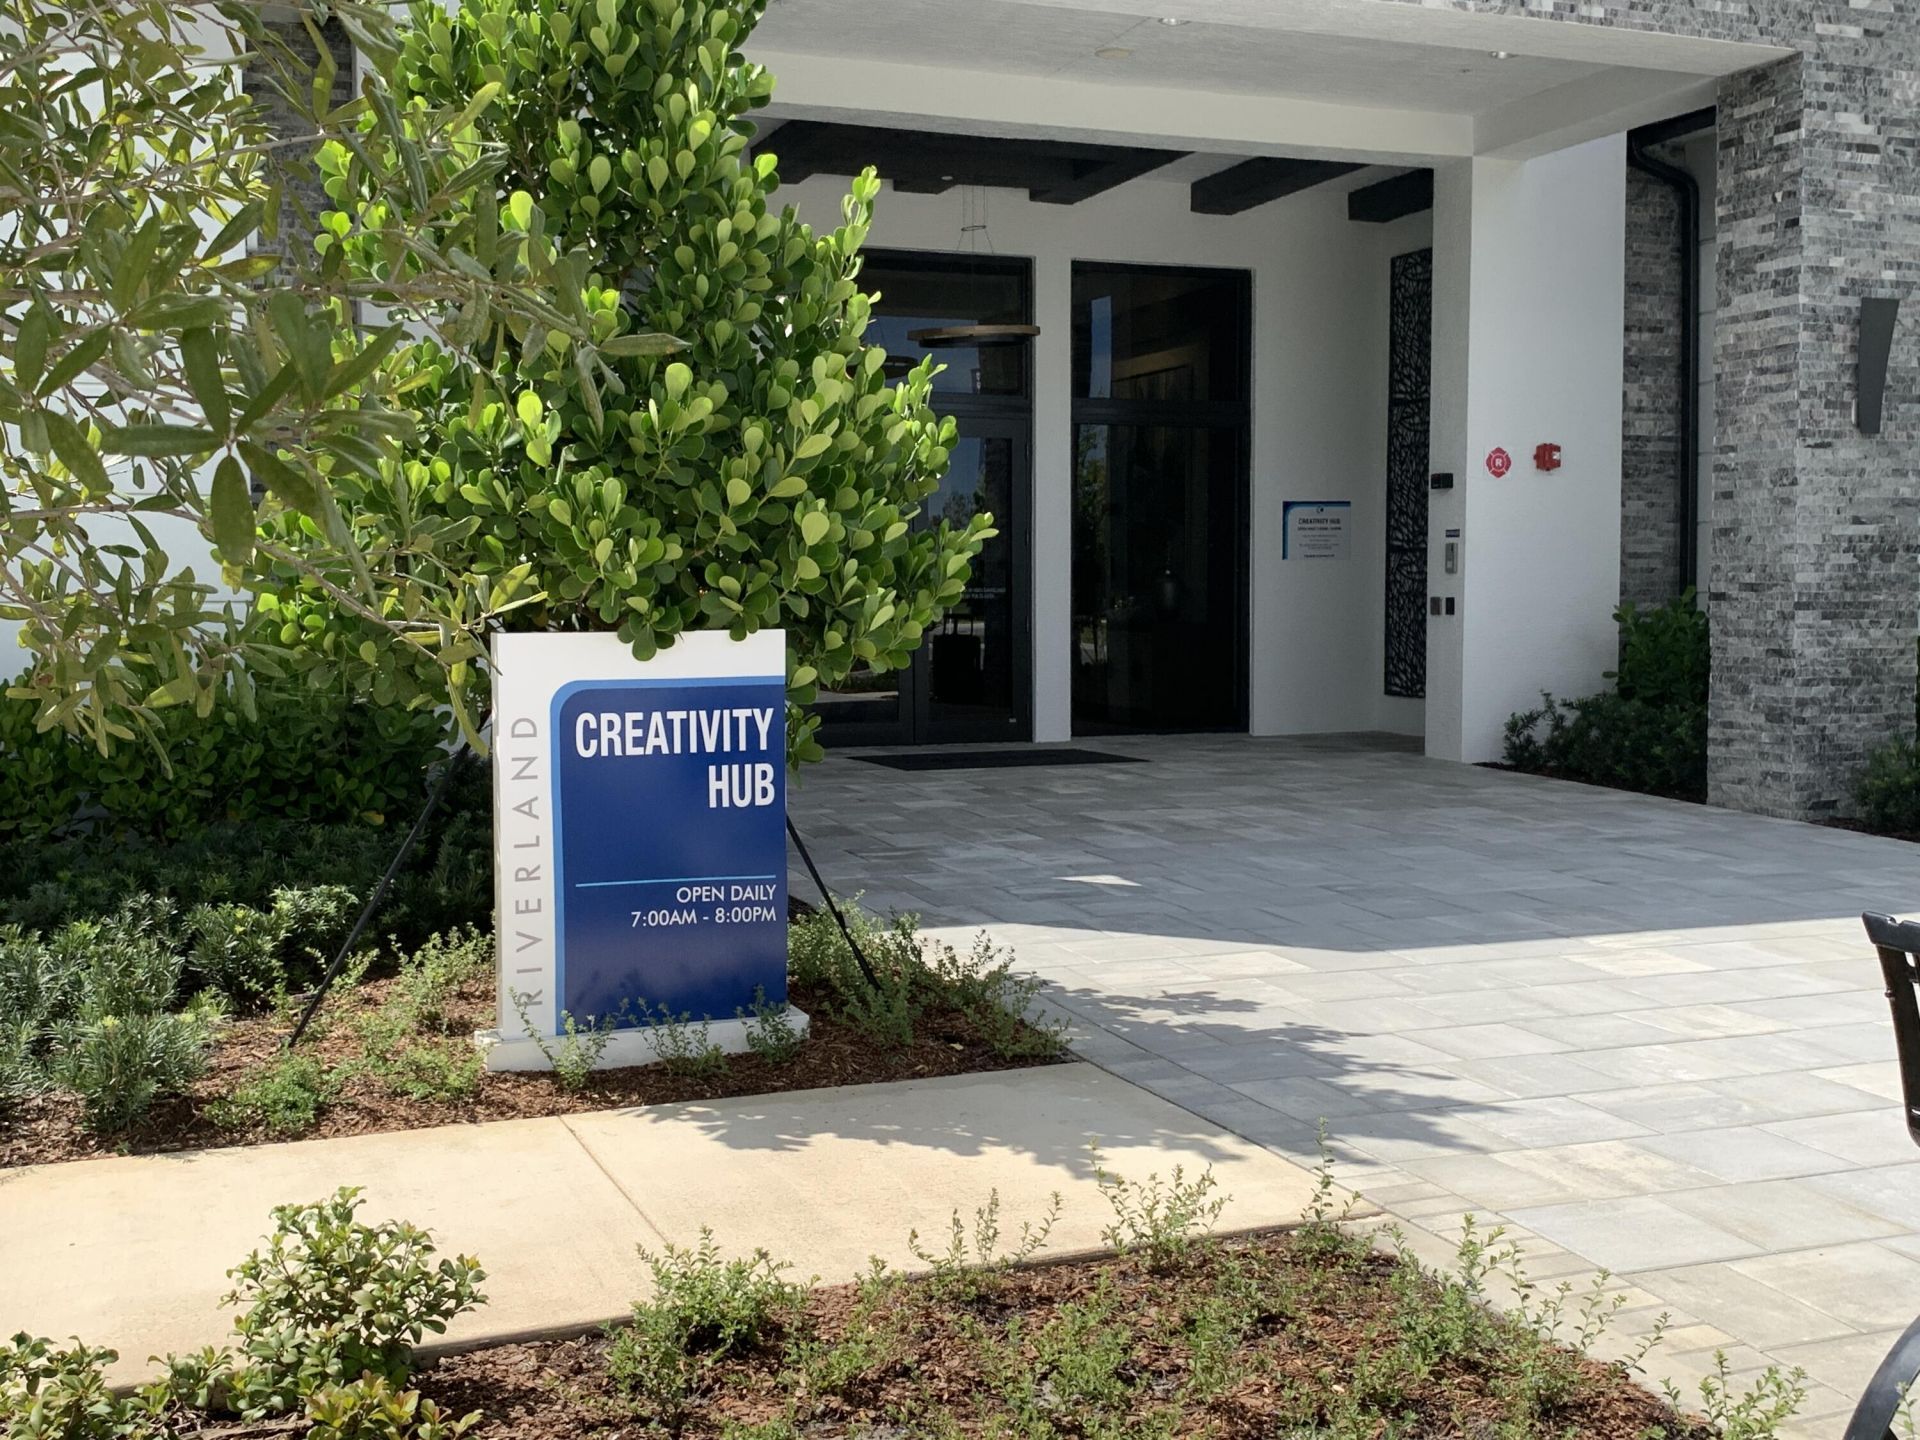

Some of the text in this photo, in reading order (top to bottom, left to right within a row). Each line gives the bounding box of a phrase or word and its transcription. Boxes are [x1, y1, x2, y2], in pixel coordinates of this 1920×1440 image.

[1495, 458, 1502, 467] R
[575, 708, 774, 758] CREATIVITY
[708, 763, 775, 808] HUB
[511, 717, 543, 1006] RIVERLAND
[676, 884, 777, 903] OPEN DAILY
[630, 908, 698, 928] 7:00AM
[714, 906, 777, 924] 8:00PM
